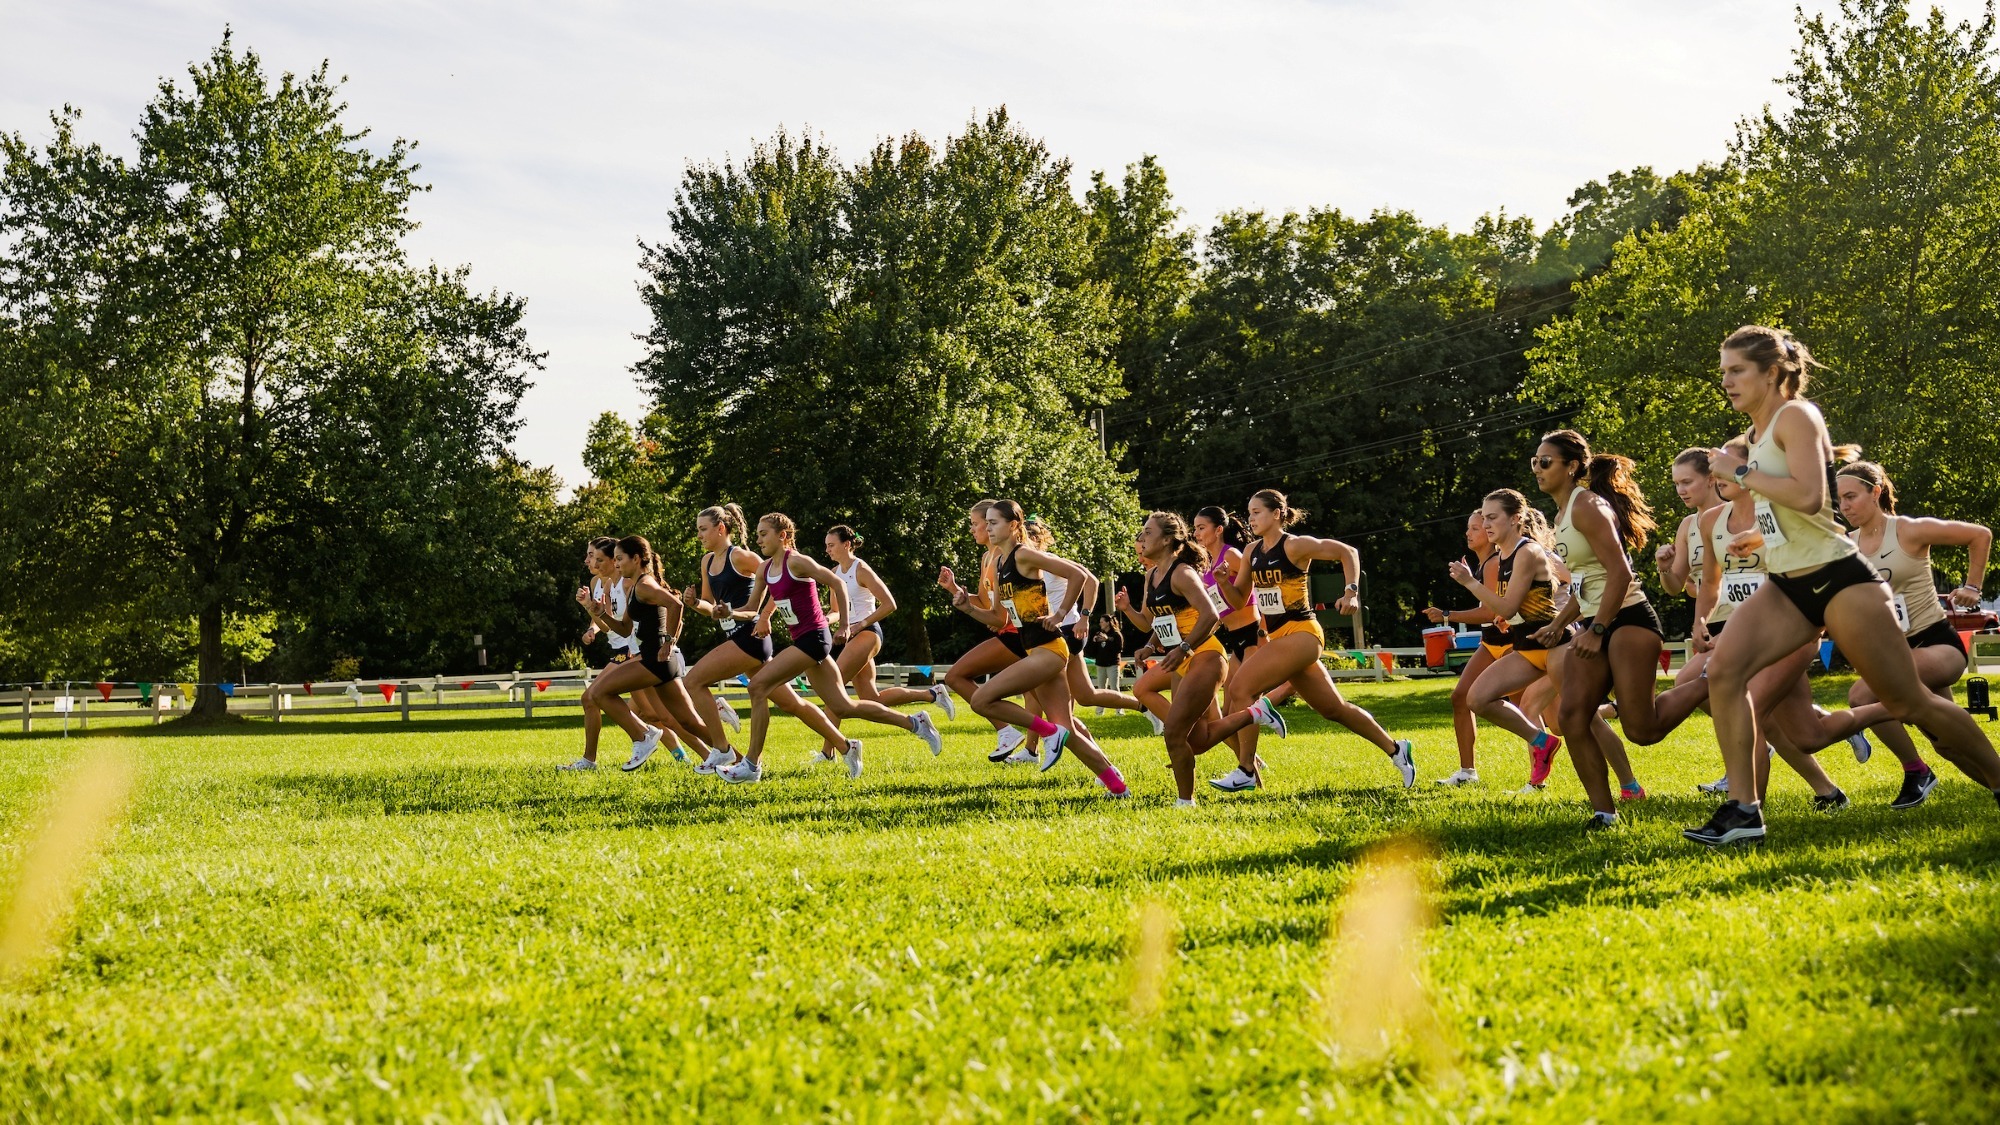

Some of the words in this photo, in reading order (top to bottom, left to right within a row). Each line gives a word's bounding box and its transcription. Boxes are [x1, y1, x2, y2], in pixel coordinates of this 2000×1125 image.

[1757, 512, 1776, 536] 693
[1258, 592, 1279, 607] 3704
[1154, 622, 1174, 640] 3707
